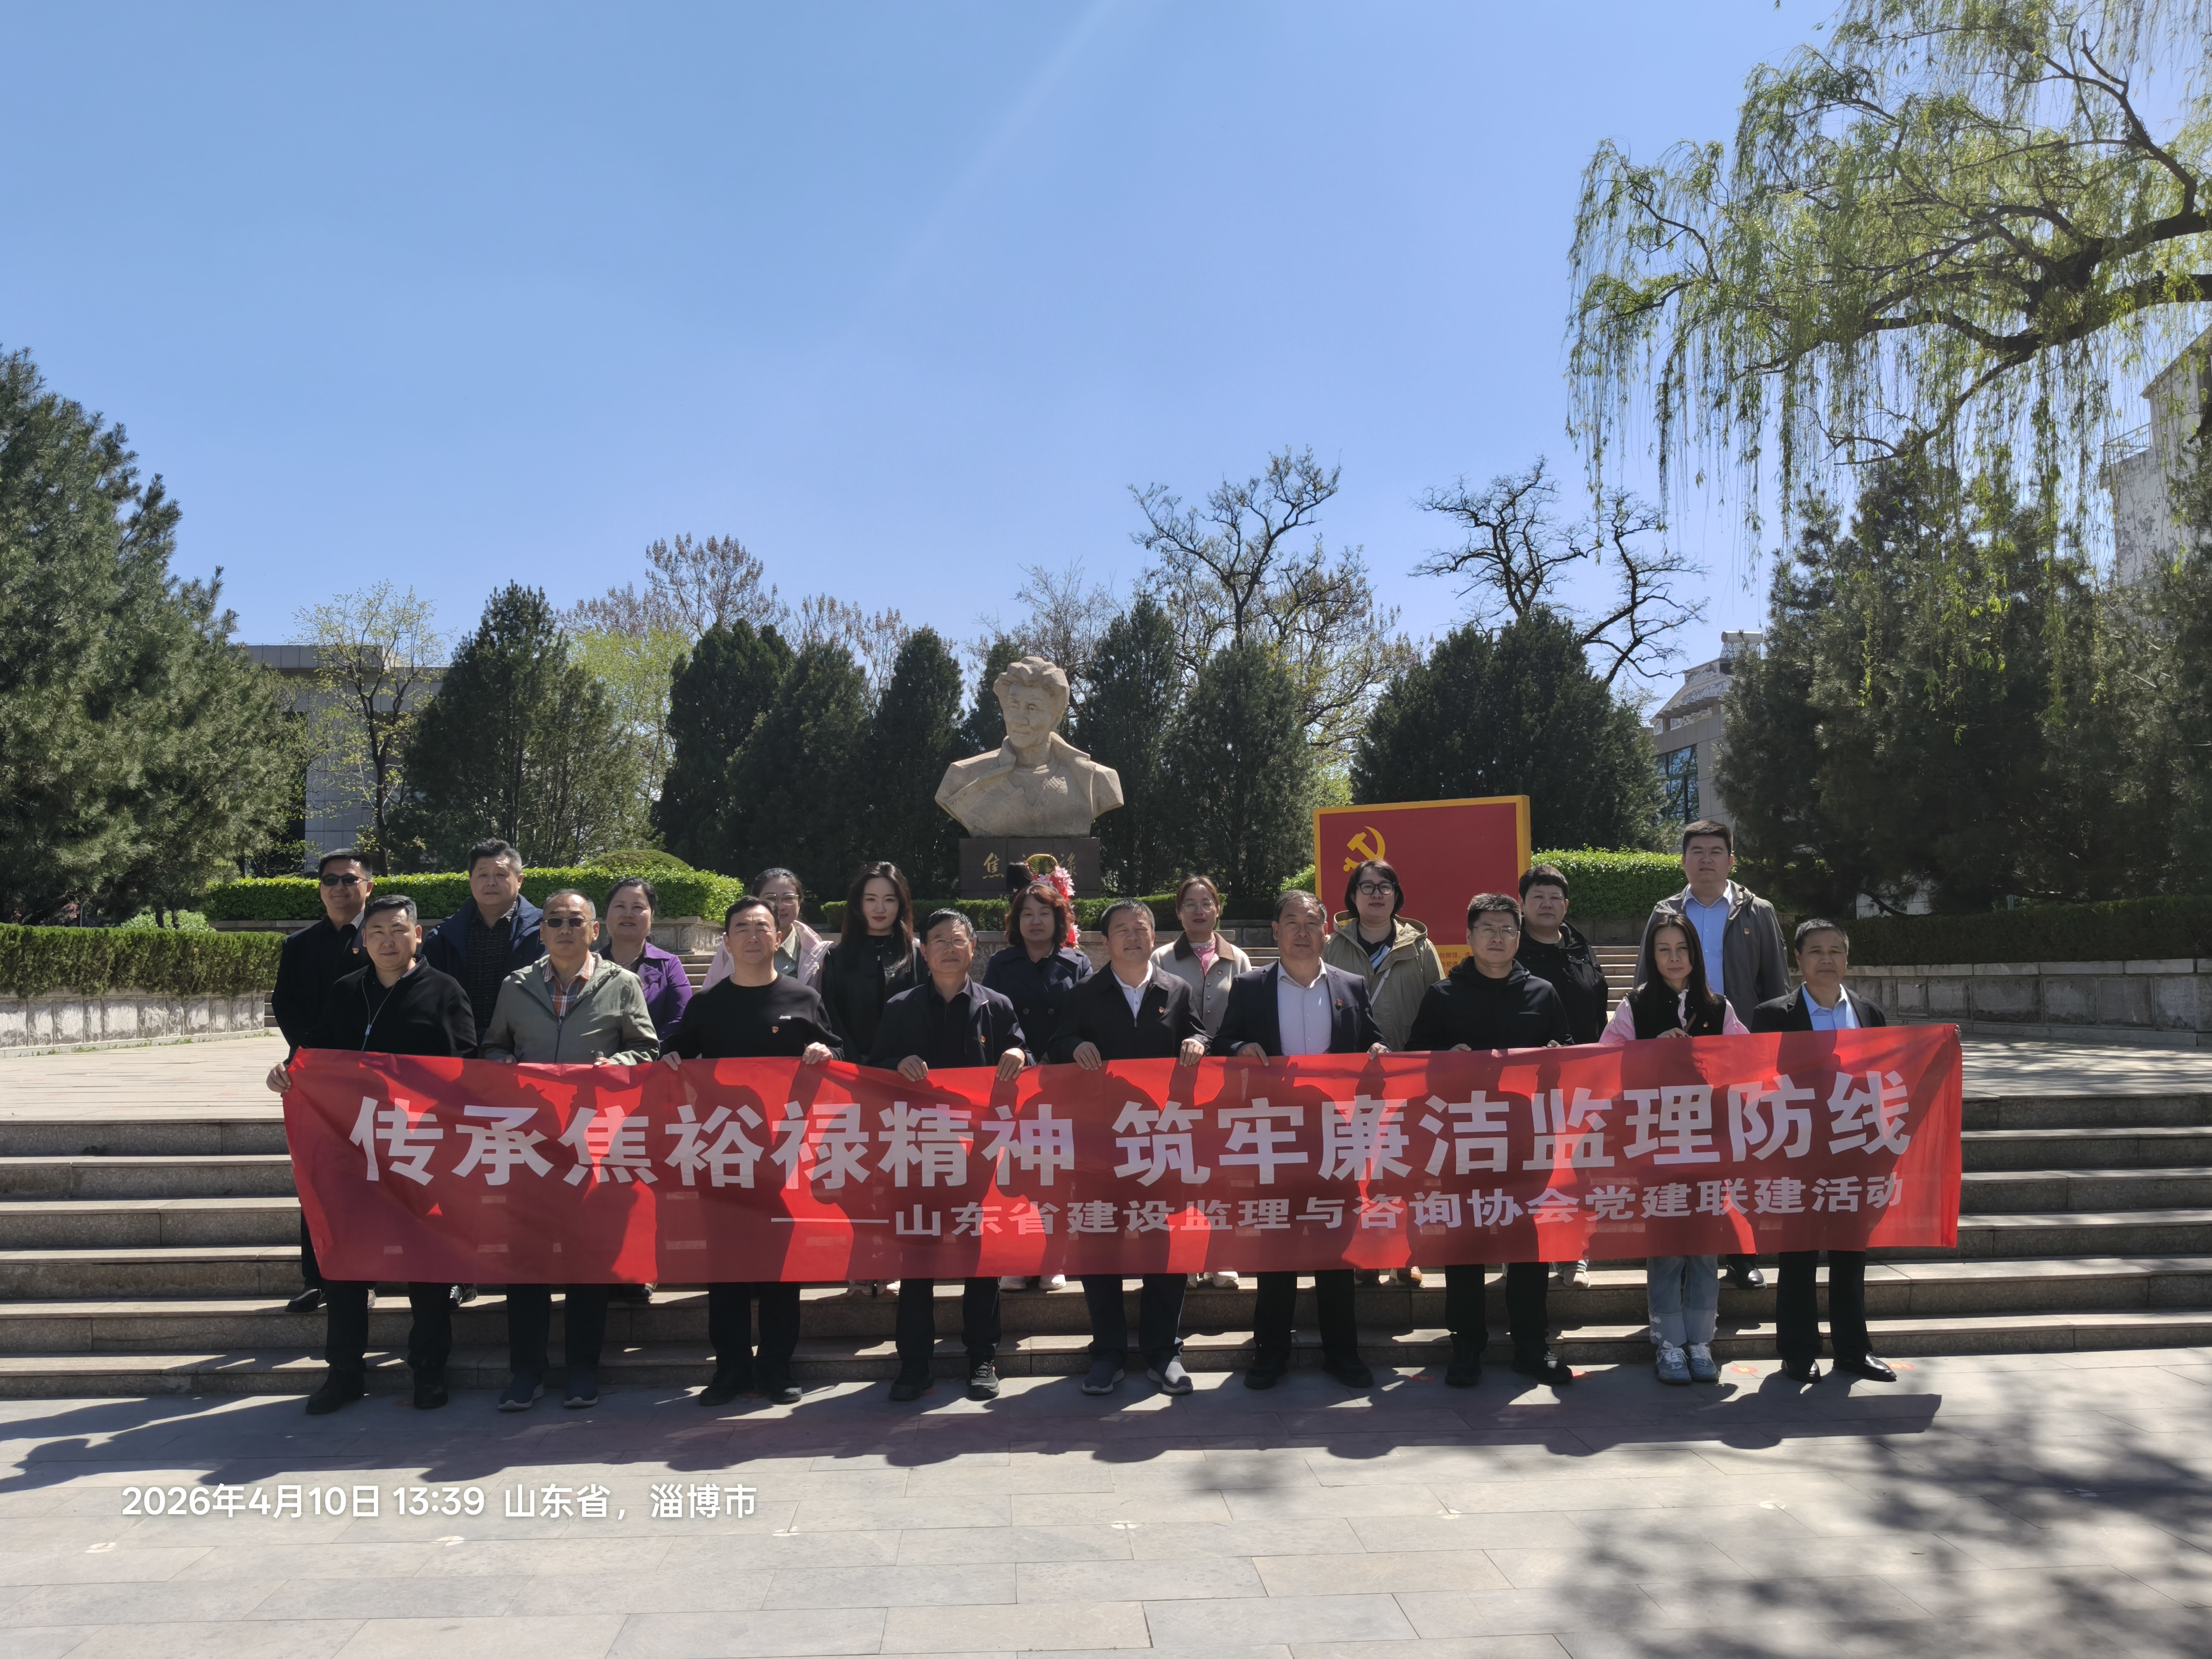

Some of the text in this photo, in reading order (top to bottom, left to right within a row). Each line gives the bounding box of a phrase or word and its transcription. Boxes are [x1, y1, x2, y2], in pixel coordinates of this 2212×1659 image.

[348, 1070, 1911, 1188] 传承焦裕禄精神 筑牢廉洁监理防线
